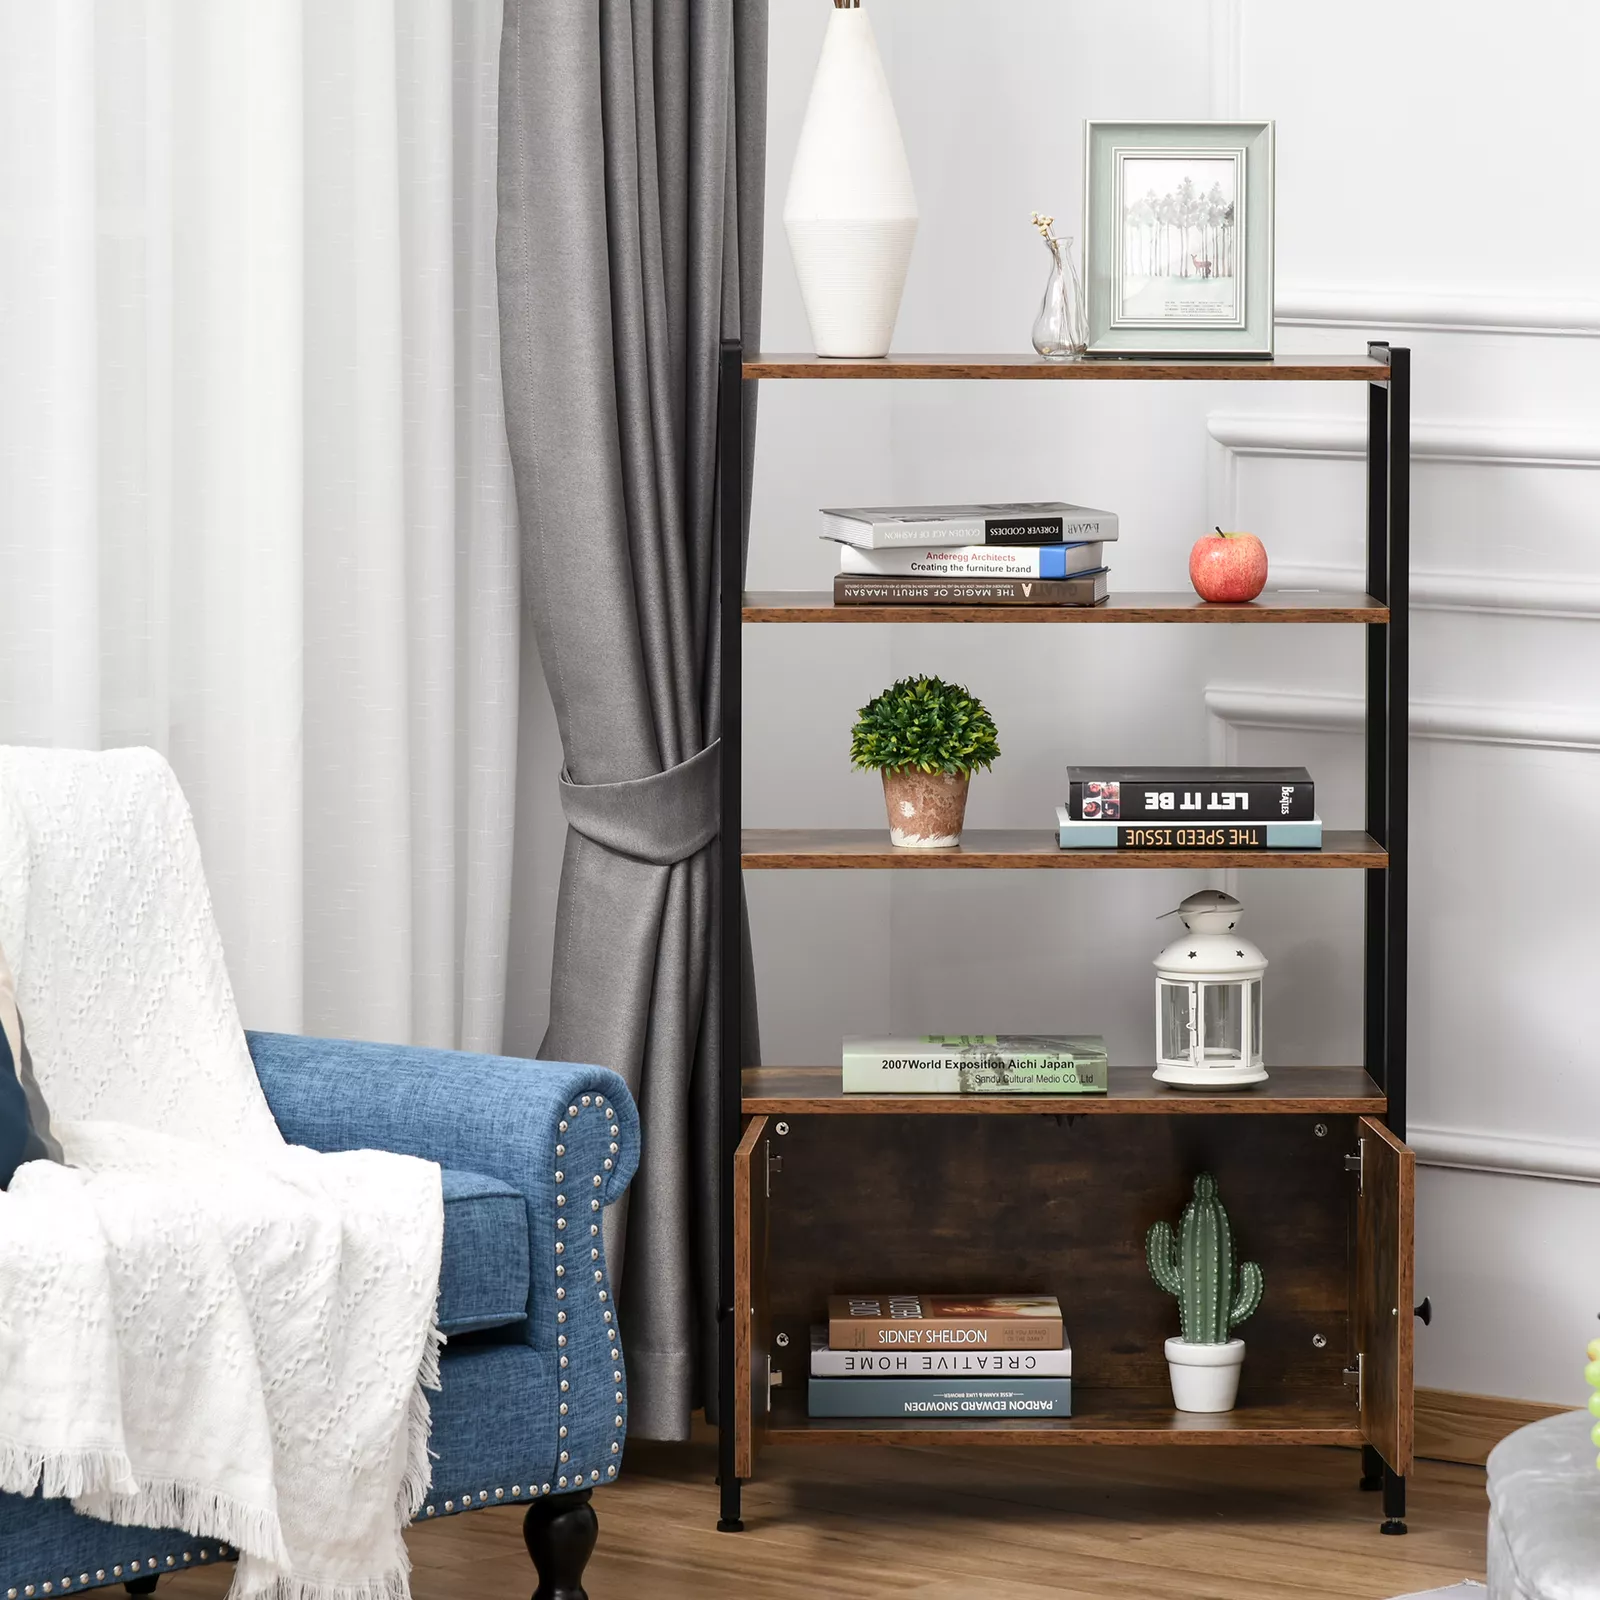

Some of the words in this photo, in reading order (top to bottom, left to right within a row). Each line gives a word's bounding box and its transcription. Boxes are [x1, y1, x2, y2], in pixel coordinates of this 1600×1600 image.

[884, 531, 917, 540] FASHION
[931, 530, 947, 538] AGE
[949, 529, 980, 537] GOLDEN
[990, 527, 1025, 536] GODDESS
[1027, 526, 1059, 534] FOREVER
[926, 552, 969, 562] Anderegg
[971, 552, 1016, 562] Architects
[911, 563, 948, 572] Creating
[950, 564, 964, 572] the
[966, 564, 1003, 572] furniture
[1006, 565, 1032, 573] brand
[1145, 793, 1174, 809] BE
[1178, 793, 1201, 810] IT
[1206, 793, 1249, 810] LET
[1126, 830, 1172, 845] ISSUE
[1177, 829, 1224, 845] SPEED
[1229, 830, 1258, 844] THE
[882, 1059, 941, 1069] 2007World
[945, 1059, 1004, 1072] Exposition
[1008, 1059, 1037, 1069] Aichi
[1040, 1059, 1074, 1072] Japan
[878, 1330, 924, 1343] SIDNEY
[926, 1330, 987, 1343] SHELDON
[844, 1357, 907, 1370] HOME
[922, 1356, 1036, 1370] CREATIVE
[904, 1401, 958, 1411] SNOWDEN
[961, 1401, 1006, 1411] EDWARD
[1009, 1400, 1053, 1410] PARDON
